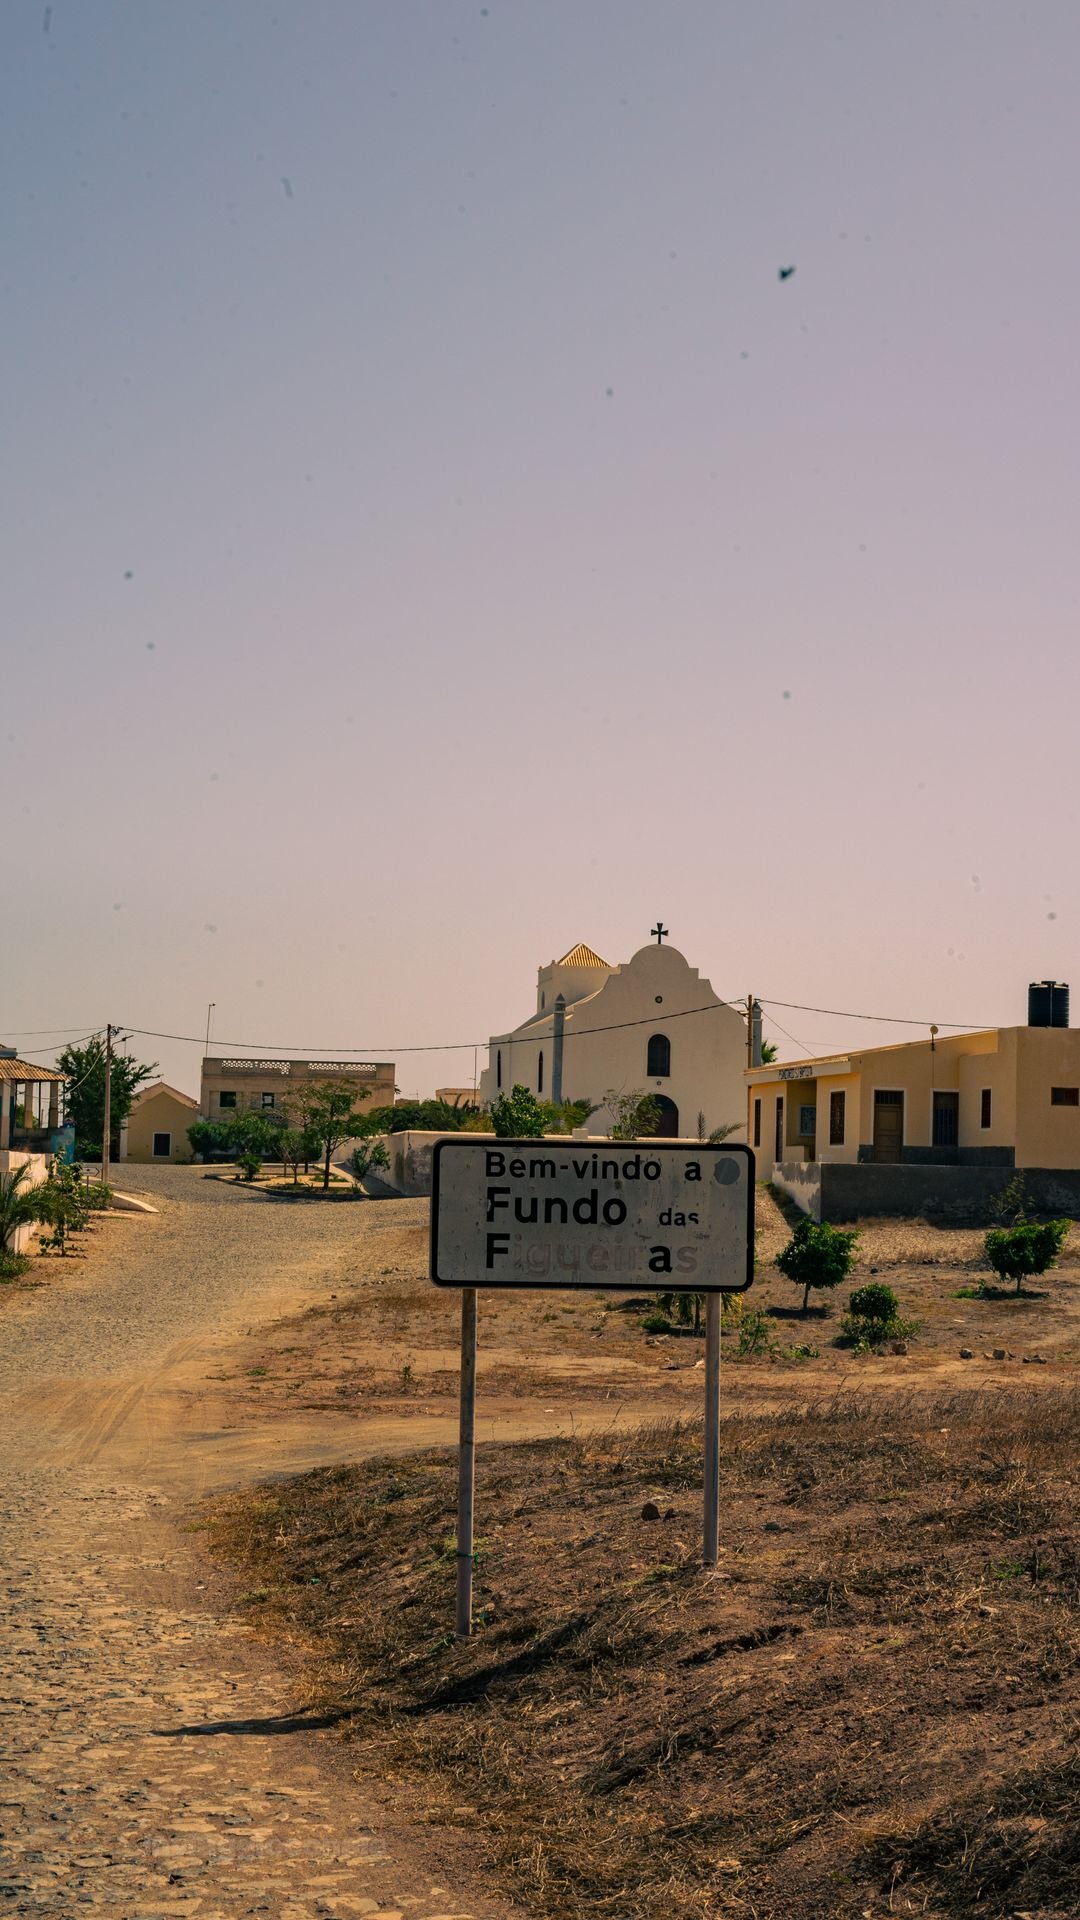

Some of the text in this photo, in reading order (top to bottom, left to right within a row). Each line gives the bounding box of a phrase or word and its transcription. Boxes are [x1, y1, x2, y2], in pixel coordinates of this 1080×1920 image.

[485, 1151, 702, 1181] Bem-vindo a
[486, 1186, 699, 1226] Fundo das
